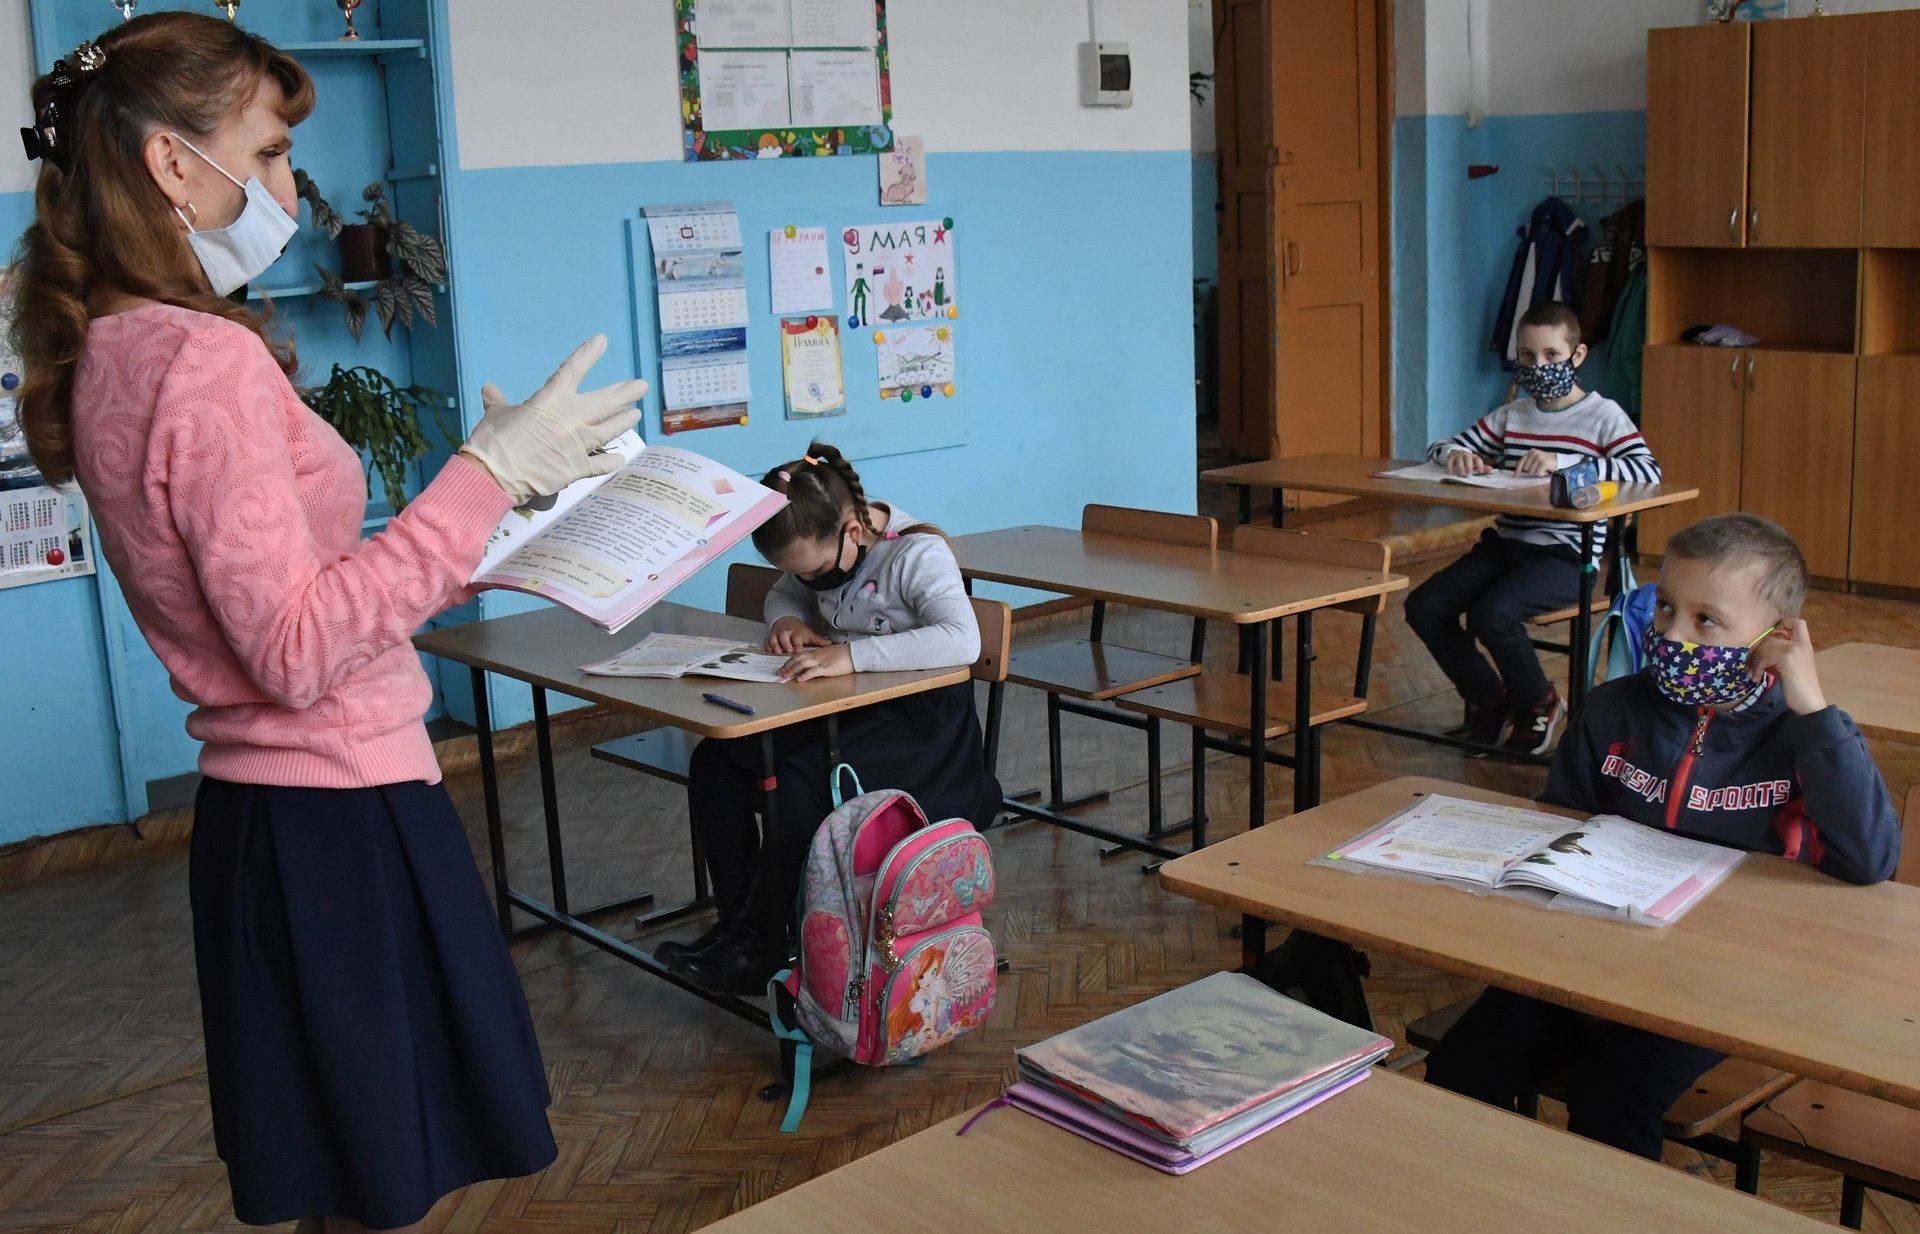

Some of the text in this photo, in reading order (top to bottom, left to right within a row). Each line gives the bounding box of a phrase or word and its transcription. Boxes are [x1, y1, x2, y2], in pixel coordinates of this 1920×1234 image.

[870, 226, 926, 252] МАЯ
[1601, 754, 1792, 812] RSSIA SPORTS
